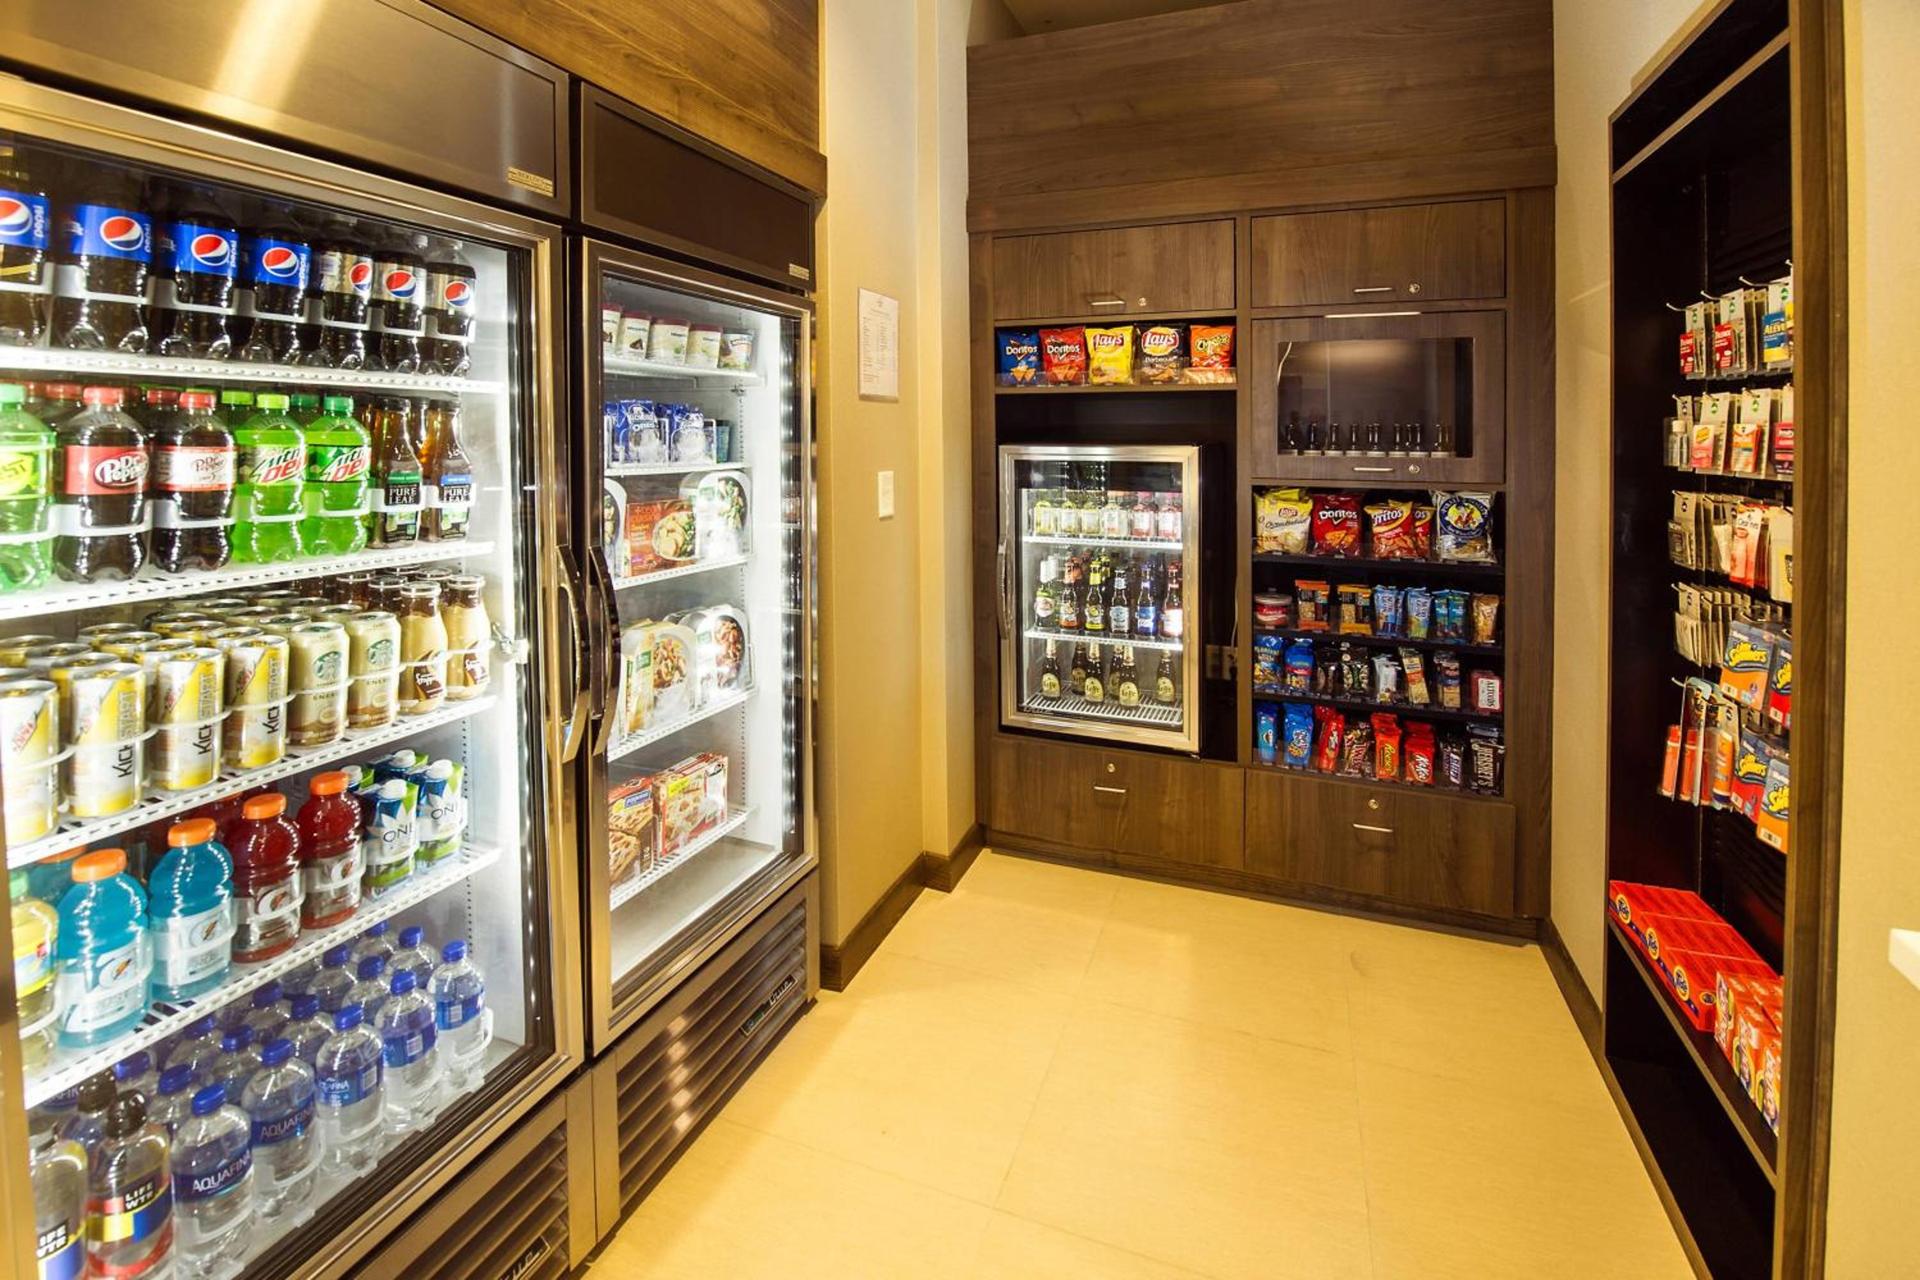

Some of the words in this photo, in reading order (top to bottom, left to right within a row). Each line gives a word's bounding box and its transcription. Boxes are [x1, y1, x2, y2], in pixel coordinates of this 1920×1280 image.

[1006, 345, 1038, 356] Doritos
[1047, 344, 1080, 354] Doritos
[389, 487, 417, 496] PURE
[1319, 504, 1358, 520] Doritos
